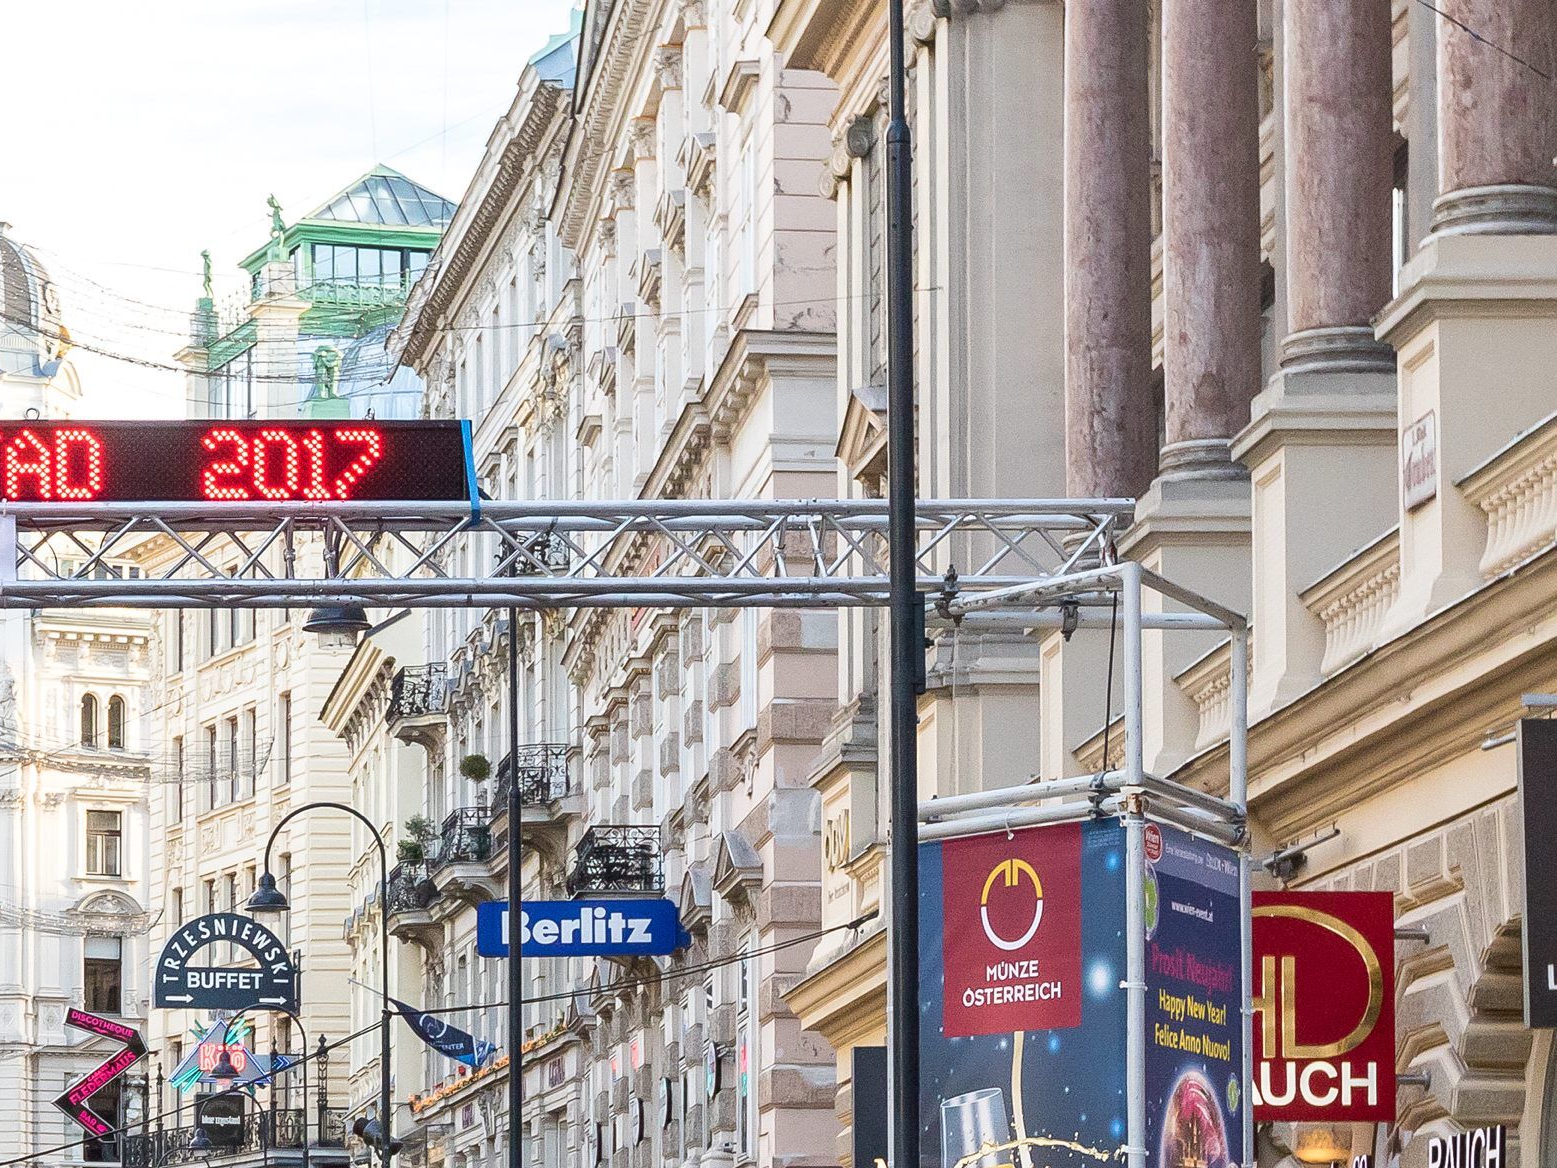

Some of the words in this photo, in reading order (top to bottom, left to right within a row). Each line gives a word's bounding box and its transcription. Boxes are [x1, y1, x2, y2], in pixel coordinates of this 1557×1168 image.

[202, 428, 383, 500] 2017
[501, 906, 652, 945] Berlitz
[162, 917, 289, 984] TRZEŚNIEWSKI
[186, 972, 264, 990] BUFFET
[985, 960, 1040, 982] MÜNZE
[962, 981, 1062, 1008] ÖSTERREICH
[1159, 988, 1186, 1021] Happy
[1187, 995, 1205, 1020] New
[1206, 1000, 1227, 1026] Year!
[71, 1010, 135, 1038] DISCOTHEQUE
[1154, 1022, 1178, 1050] Felice
[1179, 1029, 1201, 1055] Anno
[1202, 1034, 1231, 1061] Nuovo!
[69, 1051, 137, 1105] FLEDERMAUS
[79, 1109, 98, 1128] BAR
